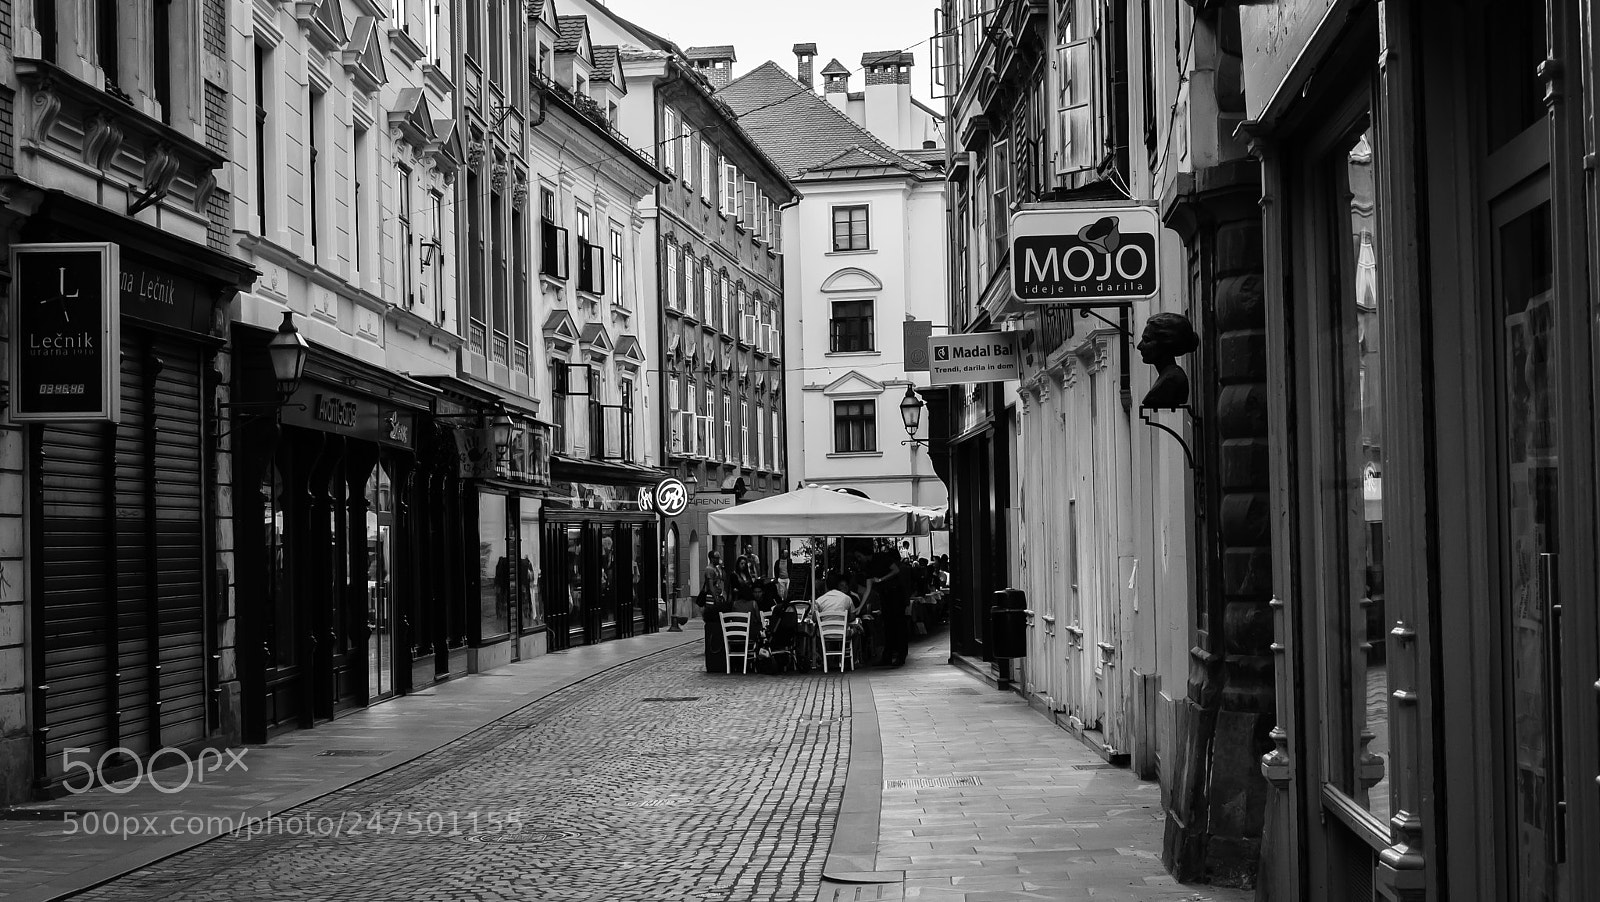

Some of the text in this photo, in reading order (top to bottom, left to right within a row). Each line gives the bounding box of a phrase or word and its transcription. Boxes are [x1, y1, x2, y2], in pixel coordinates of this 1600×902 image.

[1024, 245, 1147, 282] MOJO
[120, 271, 175, 305] na Lečnik
[1025, 282, 1143, 295] ideje in darila
[30, 332, 93, 348] Lečnik
[953, 345, 1013, 358] Madal Bal
